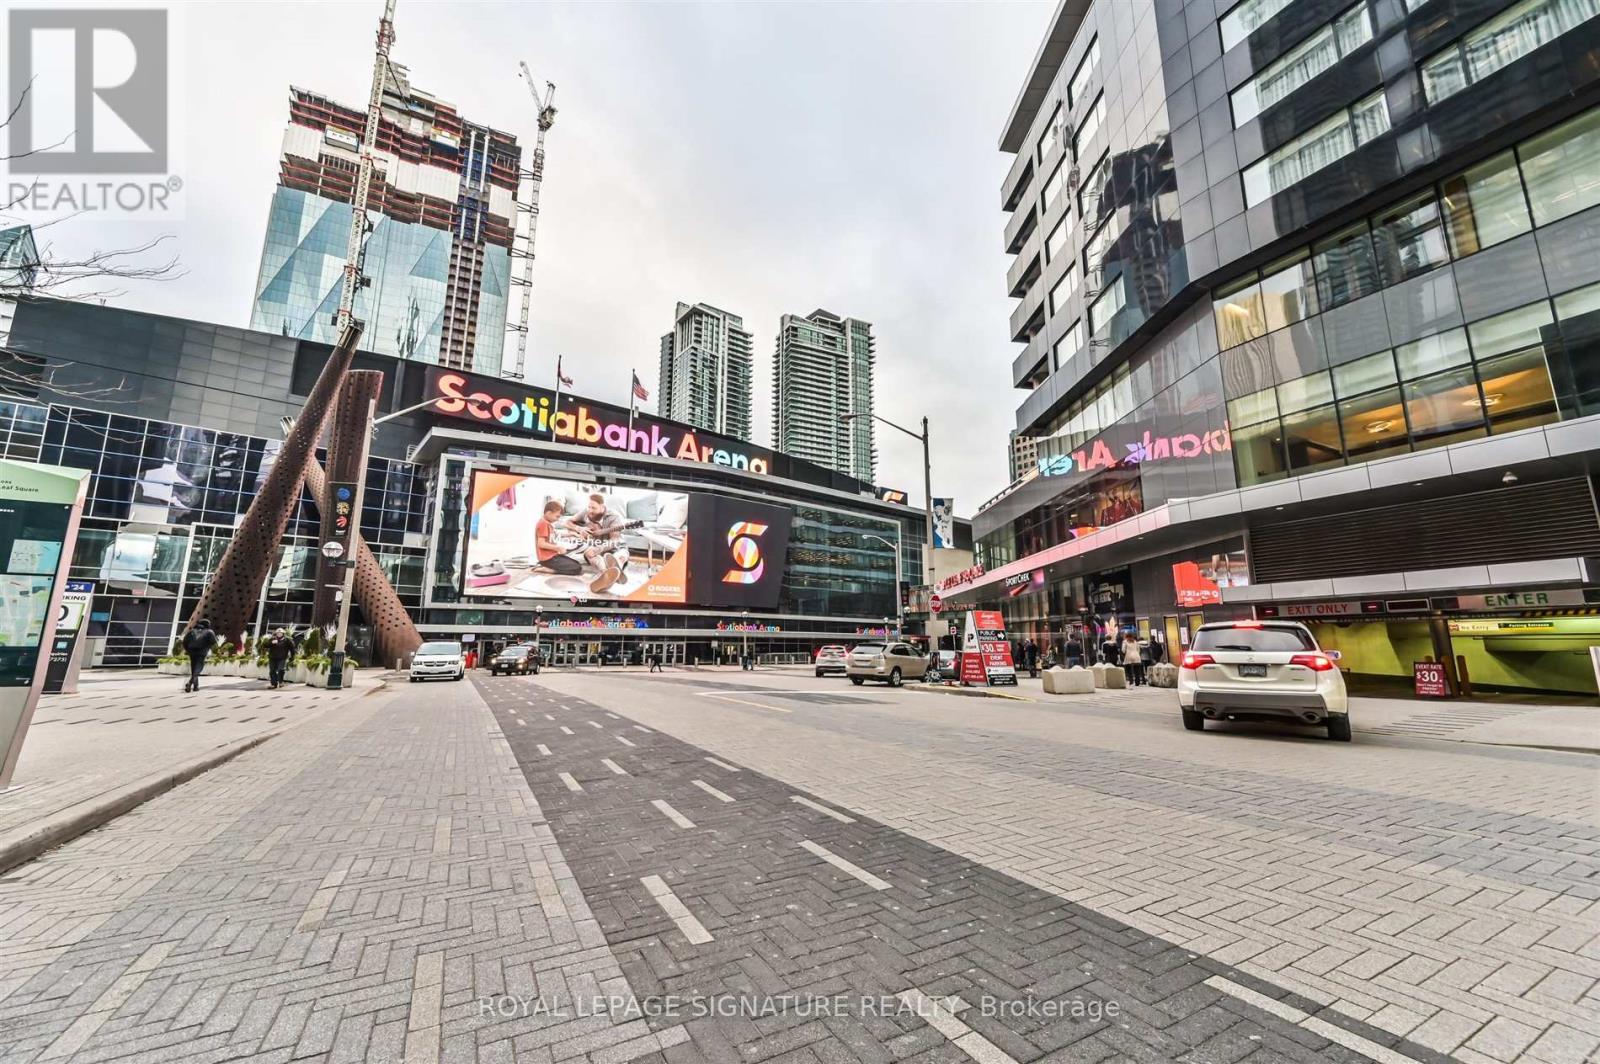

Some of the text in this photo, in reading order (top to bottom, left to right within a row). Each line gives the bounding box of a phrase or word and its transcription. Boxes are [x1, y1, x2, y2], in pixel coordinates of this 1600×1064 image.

[436, 375, 767, 475] Scotiabank Arena
[1484, 592, 1549, 607] ENTER
[1287, 604, 1349, 615] EXIT ONLY
